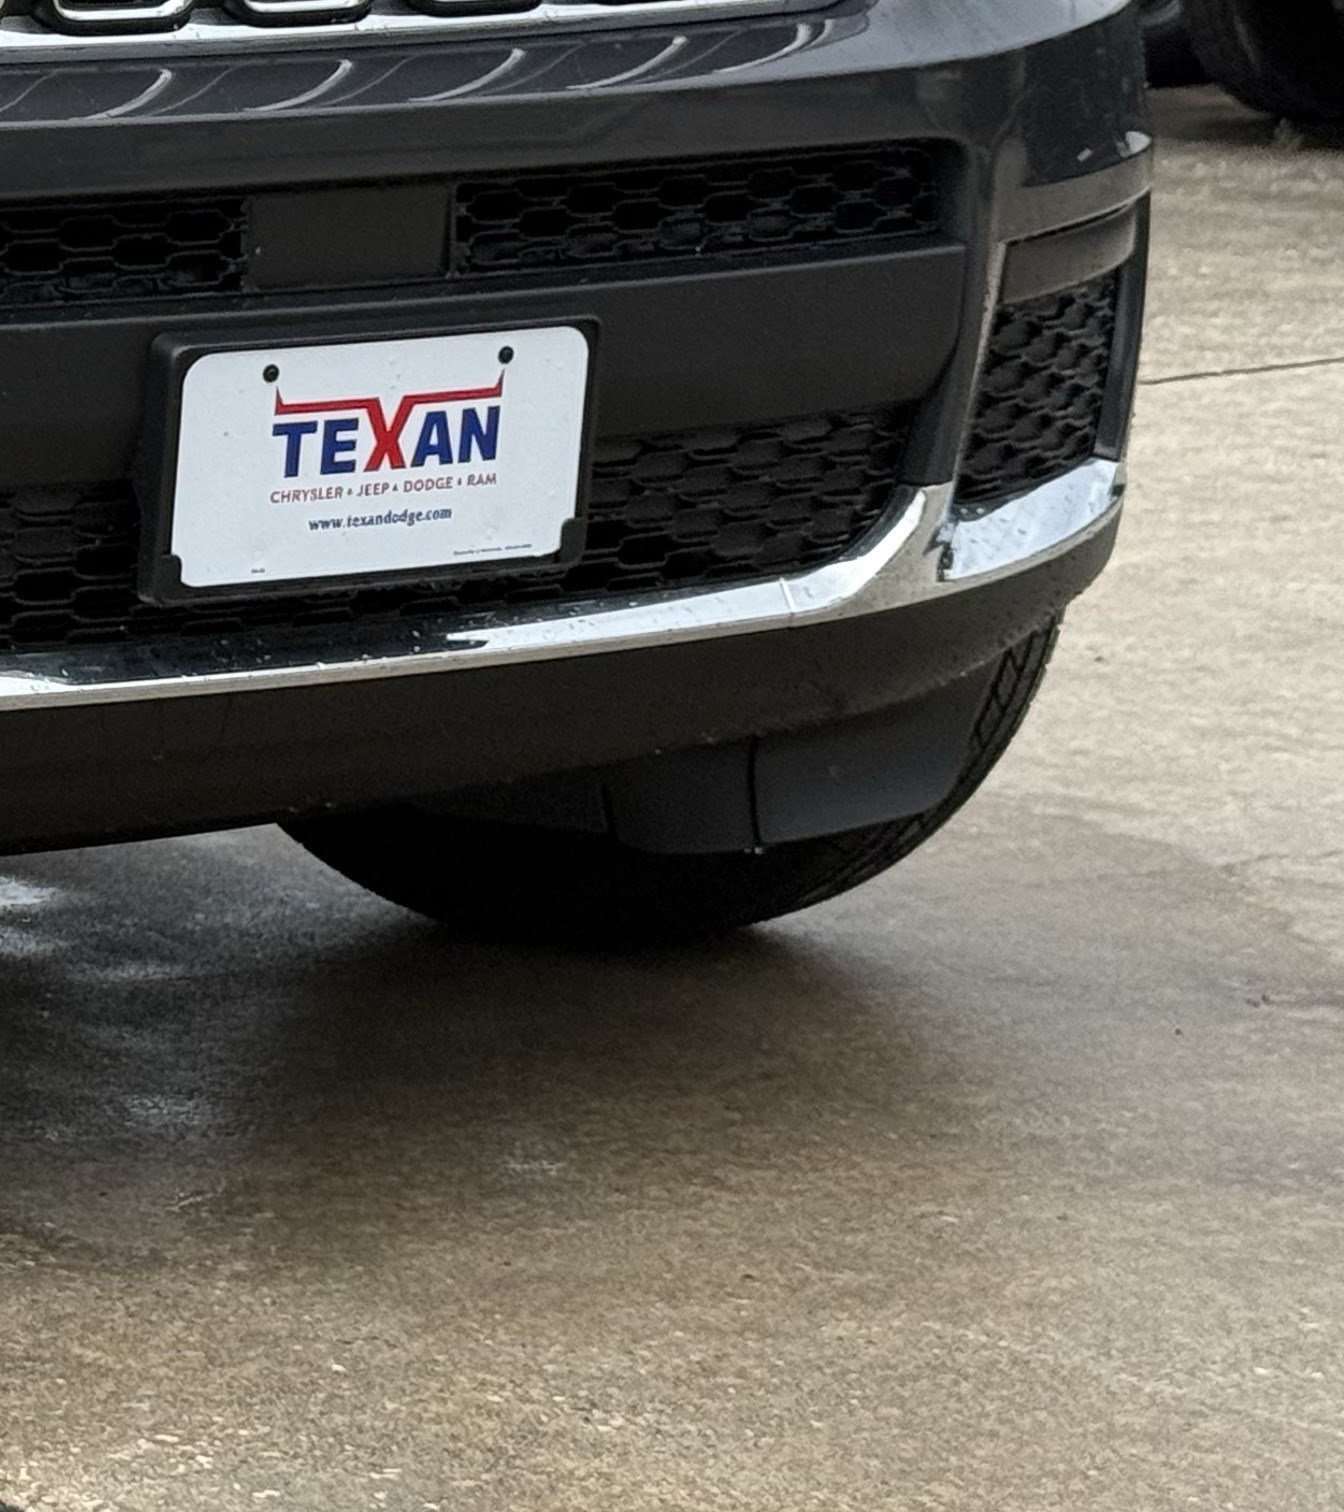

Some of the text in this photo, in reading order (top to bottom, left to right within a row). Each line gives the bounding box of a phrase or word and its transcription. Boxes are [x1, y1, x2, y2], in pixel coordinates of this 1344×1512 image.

[271, 402, 501, 478] TEXAN
[270, 473, 497, 504] CHRYSLER JEEP DODGE RAM
[308, 508, 452, 531] www.texandodge.com
